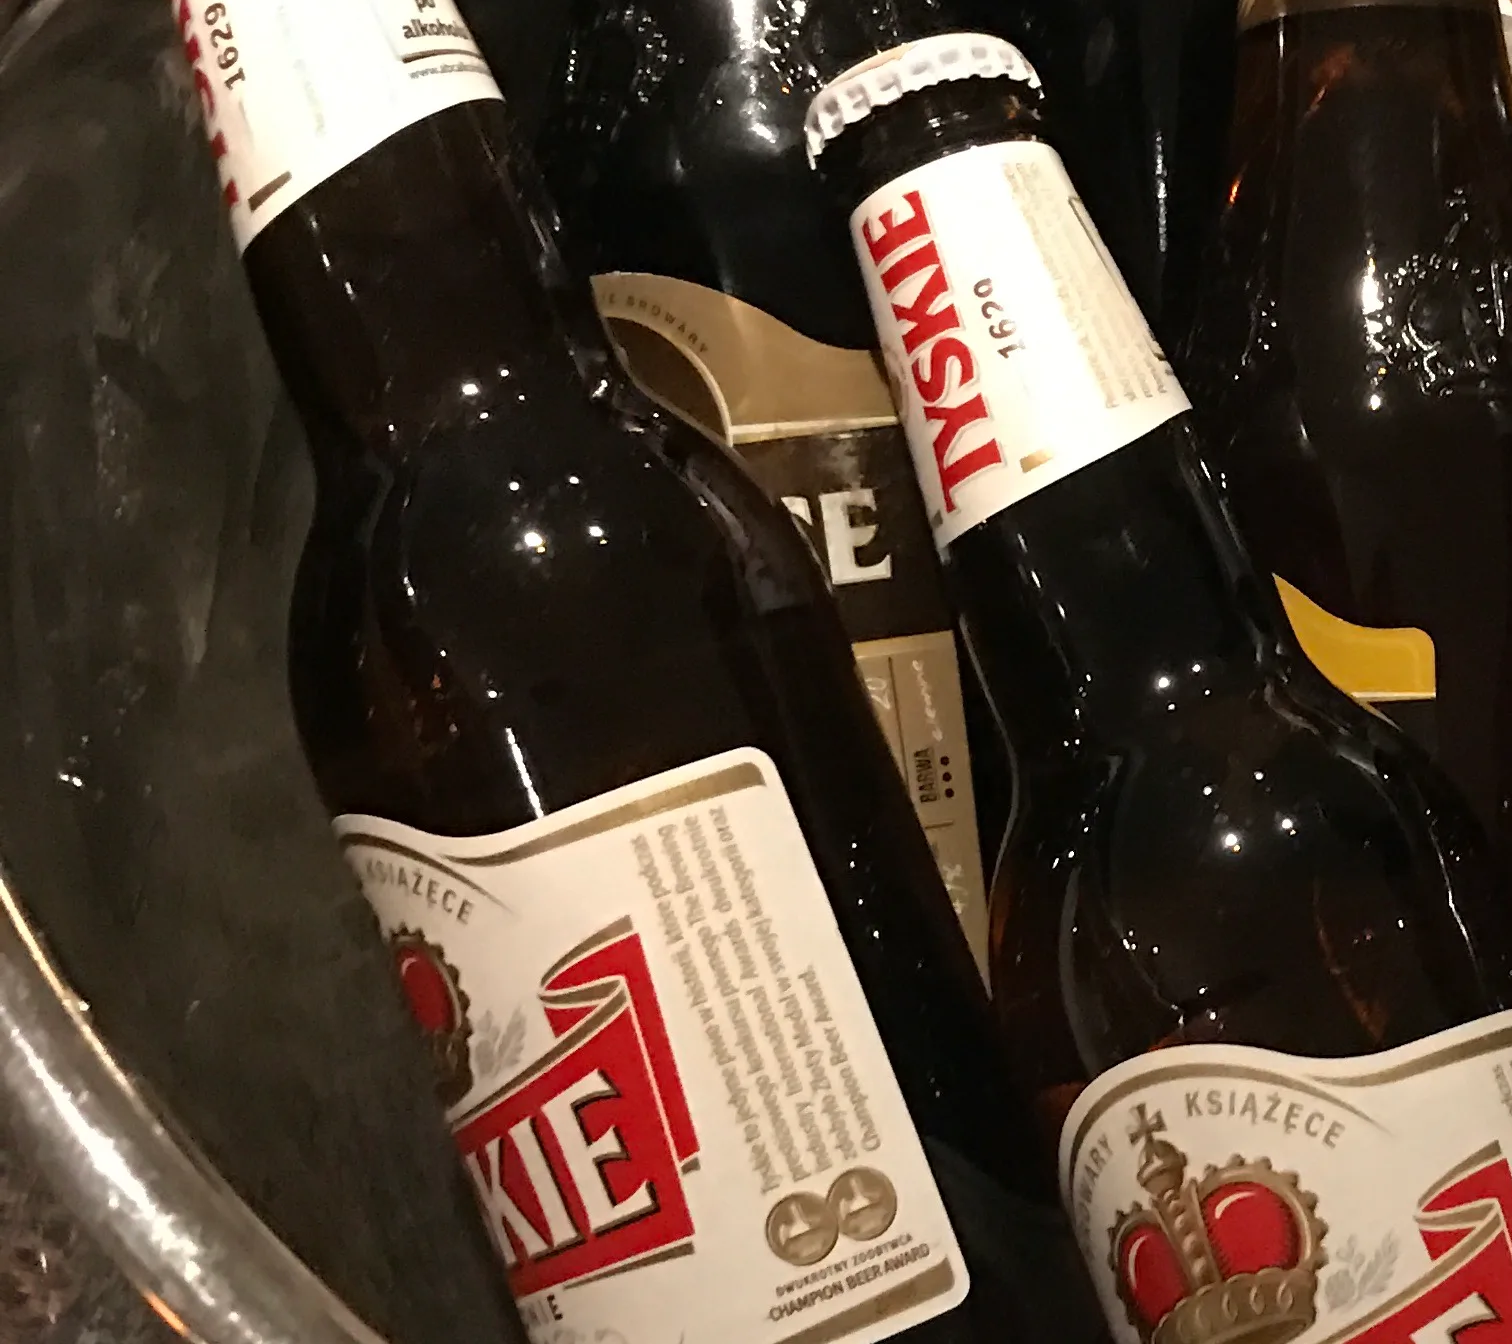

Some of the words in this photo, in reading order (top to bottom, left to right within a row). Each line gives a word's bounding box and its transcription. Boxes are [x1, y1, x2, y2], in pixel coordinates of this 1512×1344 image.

[203, 2, 246, 90] 1629
[862, 189, 1005, 515] TYSKIE
[1184, 1089, 1346, 1150] KSIĄŻĘCE
[768, 1280, 845, 1322] CHAMPION
[845, 1264, 884, 1291] BEER
[883, 1243, 931, 1274] AWARD
